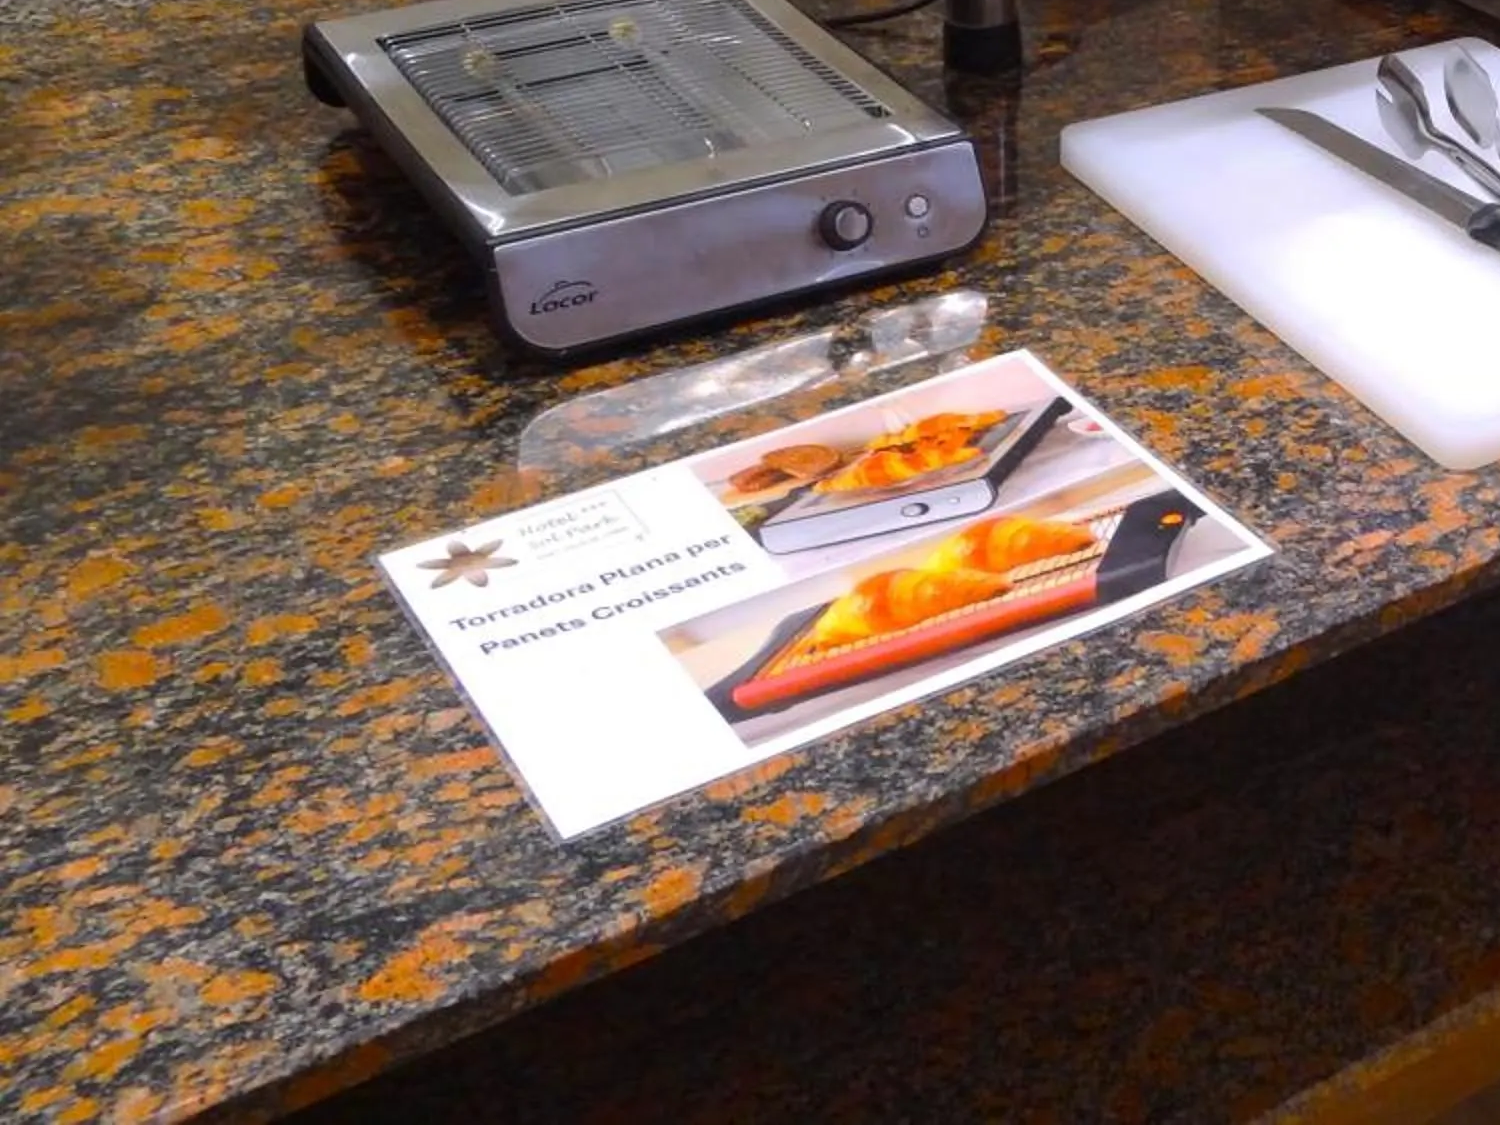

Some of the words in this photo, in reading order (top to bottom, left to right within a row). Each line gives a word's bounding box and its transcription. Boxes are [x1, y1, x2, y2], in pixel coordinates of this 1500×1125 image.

[449, 581, 596, 632] Torradora
[599, 550, 682, 586] Plana
[685, 533, 733, 559] per
[479, 617, 587, 655] Panets
[591, 560, 748, 622] Croissants
